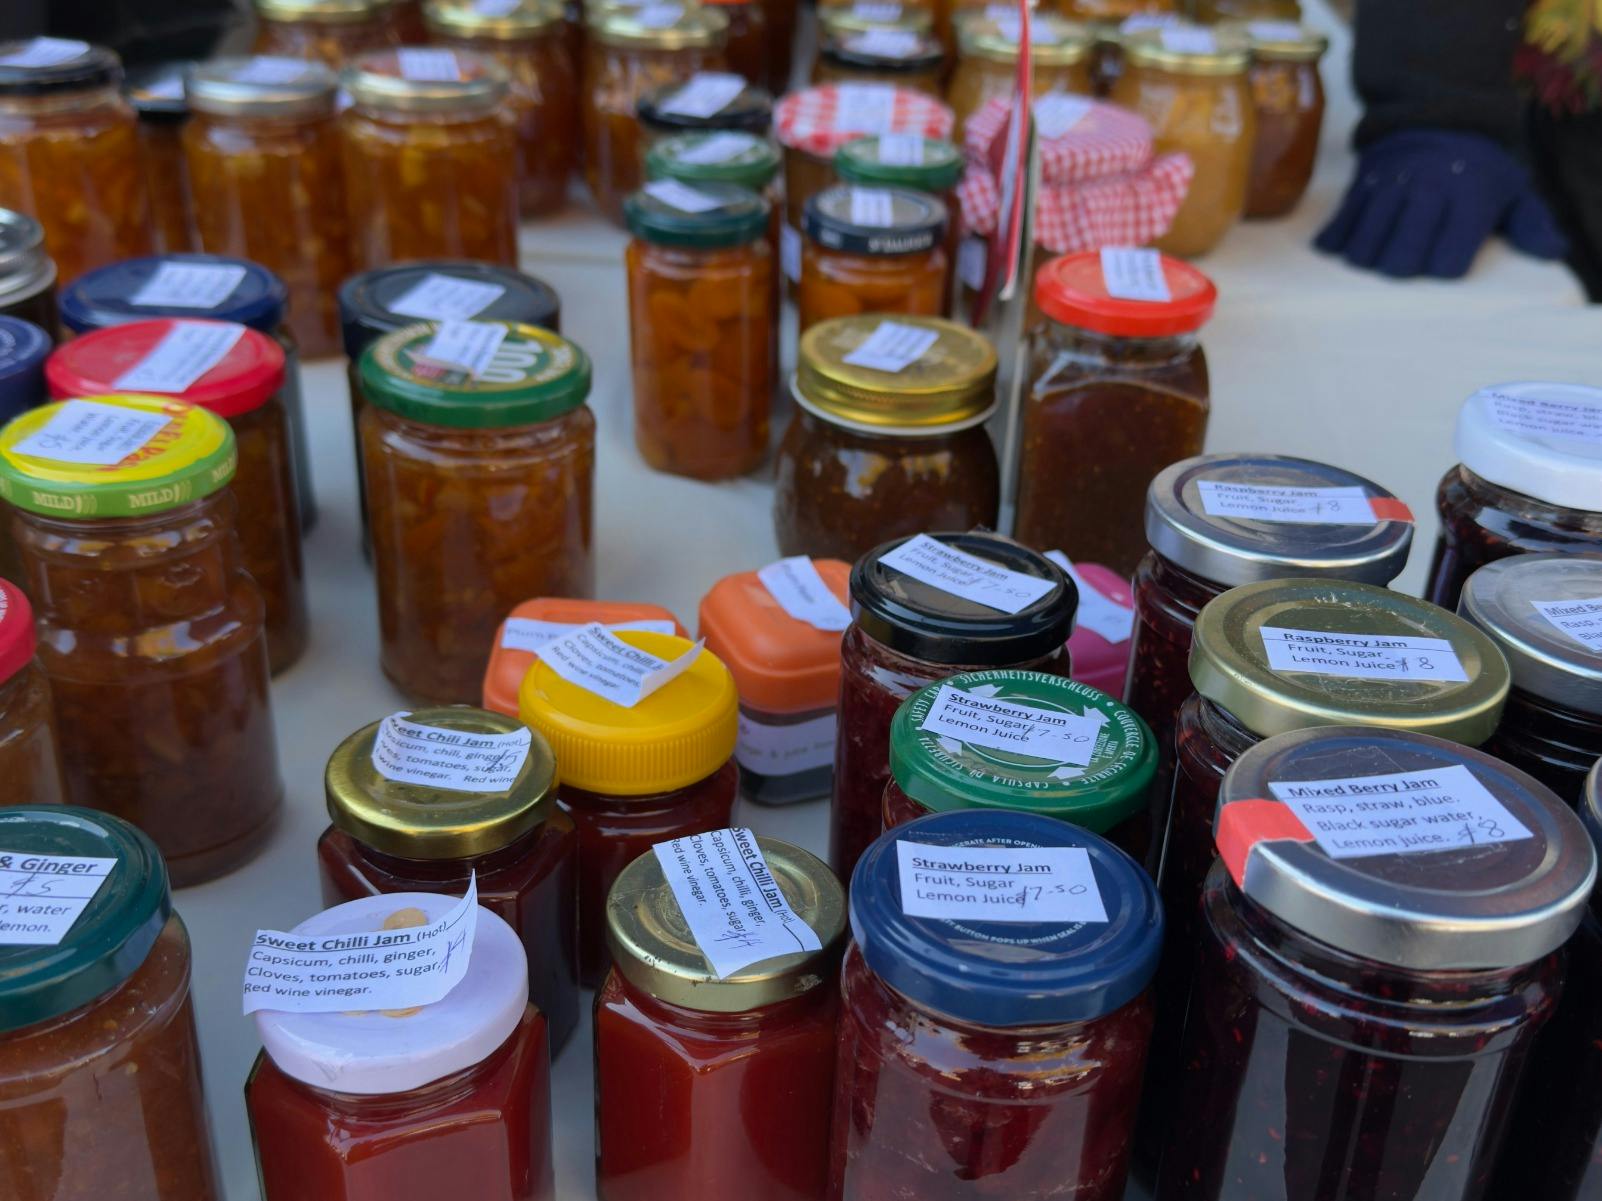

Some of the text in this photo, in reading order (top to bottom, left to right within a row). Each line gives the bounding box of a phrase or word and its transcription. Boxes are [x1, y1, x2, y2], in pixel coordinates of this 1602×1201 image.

[129, 488, 175, 508] MILD
[1214, 483, 1319, 498] Raspberry Jam
[32, 490, 75, 510] MILD
[1219, 502, 1270, 513] Lemon
[899, 554, 937, 575] Lemon
[920, 541, 1009, 582] Strawberry Jam
[941, 561, 974, 578] Sugar
[1543, 604, 1587, 616] Mixed
[588, 627, 626, 655] Sweet
[624, 650, 657, 668] Chilli
[1283, 633, 1409, 649] Raspberry Jam
[552, 646, 570, 661] Red
[568, 661, 589, 675] wine
[1293, 655, 1396, 670] Lemon Juice
[944, 704, 981, 722] Fruit,
[949, 692, 1068, 726] Strawberry Jam
[938, 714, 1031, 743] Lemon Juice
[461, 738, 494, 749] Jam
[379, 754, 403, 772] wine
[464, 775, 487, 784] Red
[406, 755, 470, 772] tomatoes,
[1288, 777, 1440, 799] Mixed Berry Jam
[1302, 801, 1354, 815] Rasp,
[1316, 819, 1366, 832] Black
[1372, 815, 1418, 830] sugar
[1332, 836, 1396, 850] Lemon
[20, 858, 99, 874] Ginger
[671, 838, 708, 906] Red wine vinegar.
[689, 835, 710, 867] Cloves,
[704, 867, 732, 911] tomatoes,
[732, 827, 758, 861] Sweet
[750, 858, 776, 890] Chilli
[763, 887, 784, 910] Jam
[912, 857, 1052, 874] Strawberry Jam
[710, 830, 766, 927] Capsicum, chilli, ginger,
[914, 873, 1015, 891] Fruit, Sugar
[916, 889, 1023, 905] Lemon Juice
[17, 904, 73, 916] water
[256, 933, 317, 951] Sweet
[322, 935, 369, 951] Chilli
[373, 932, 411, 947] Jam
[990, 936, 1015, 945] POPS
[252, 948, 436, 968] Capsicum, chilli, ginger,
[248, 962, 441, 984] Cloves, tomatoes, sugar,
[244, 983, 373, 998] Red wine vinegar.
